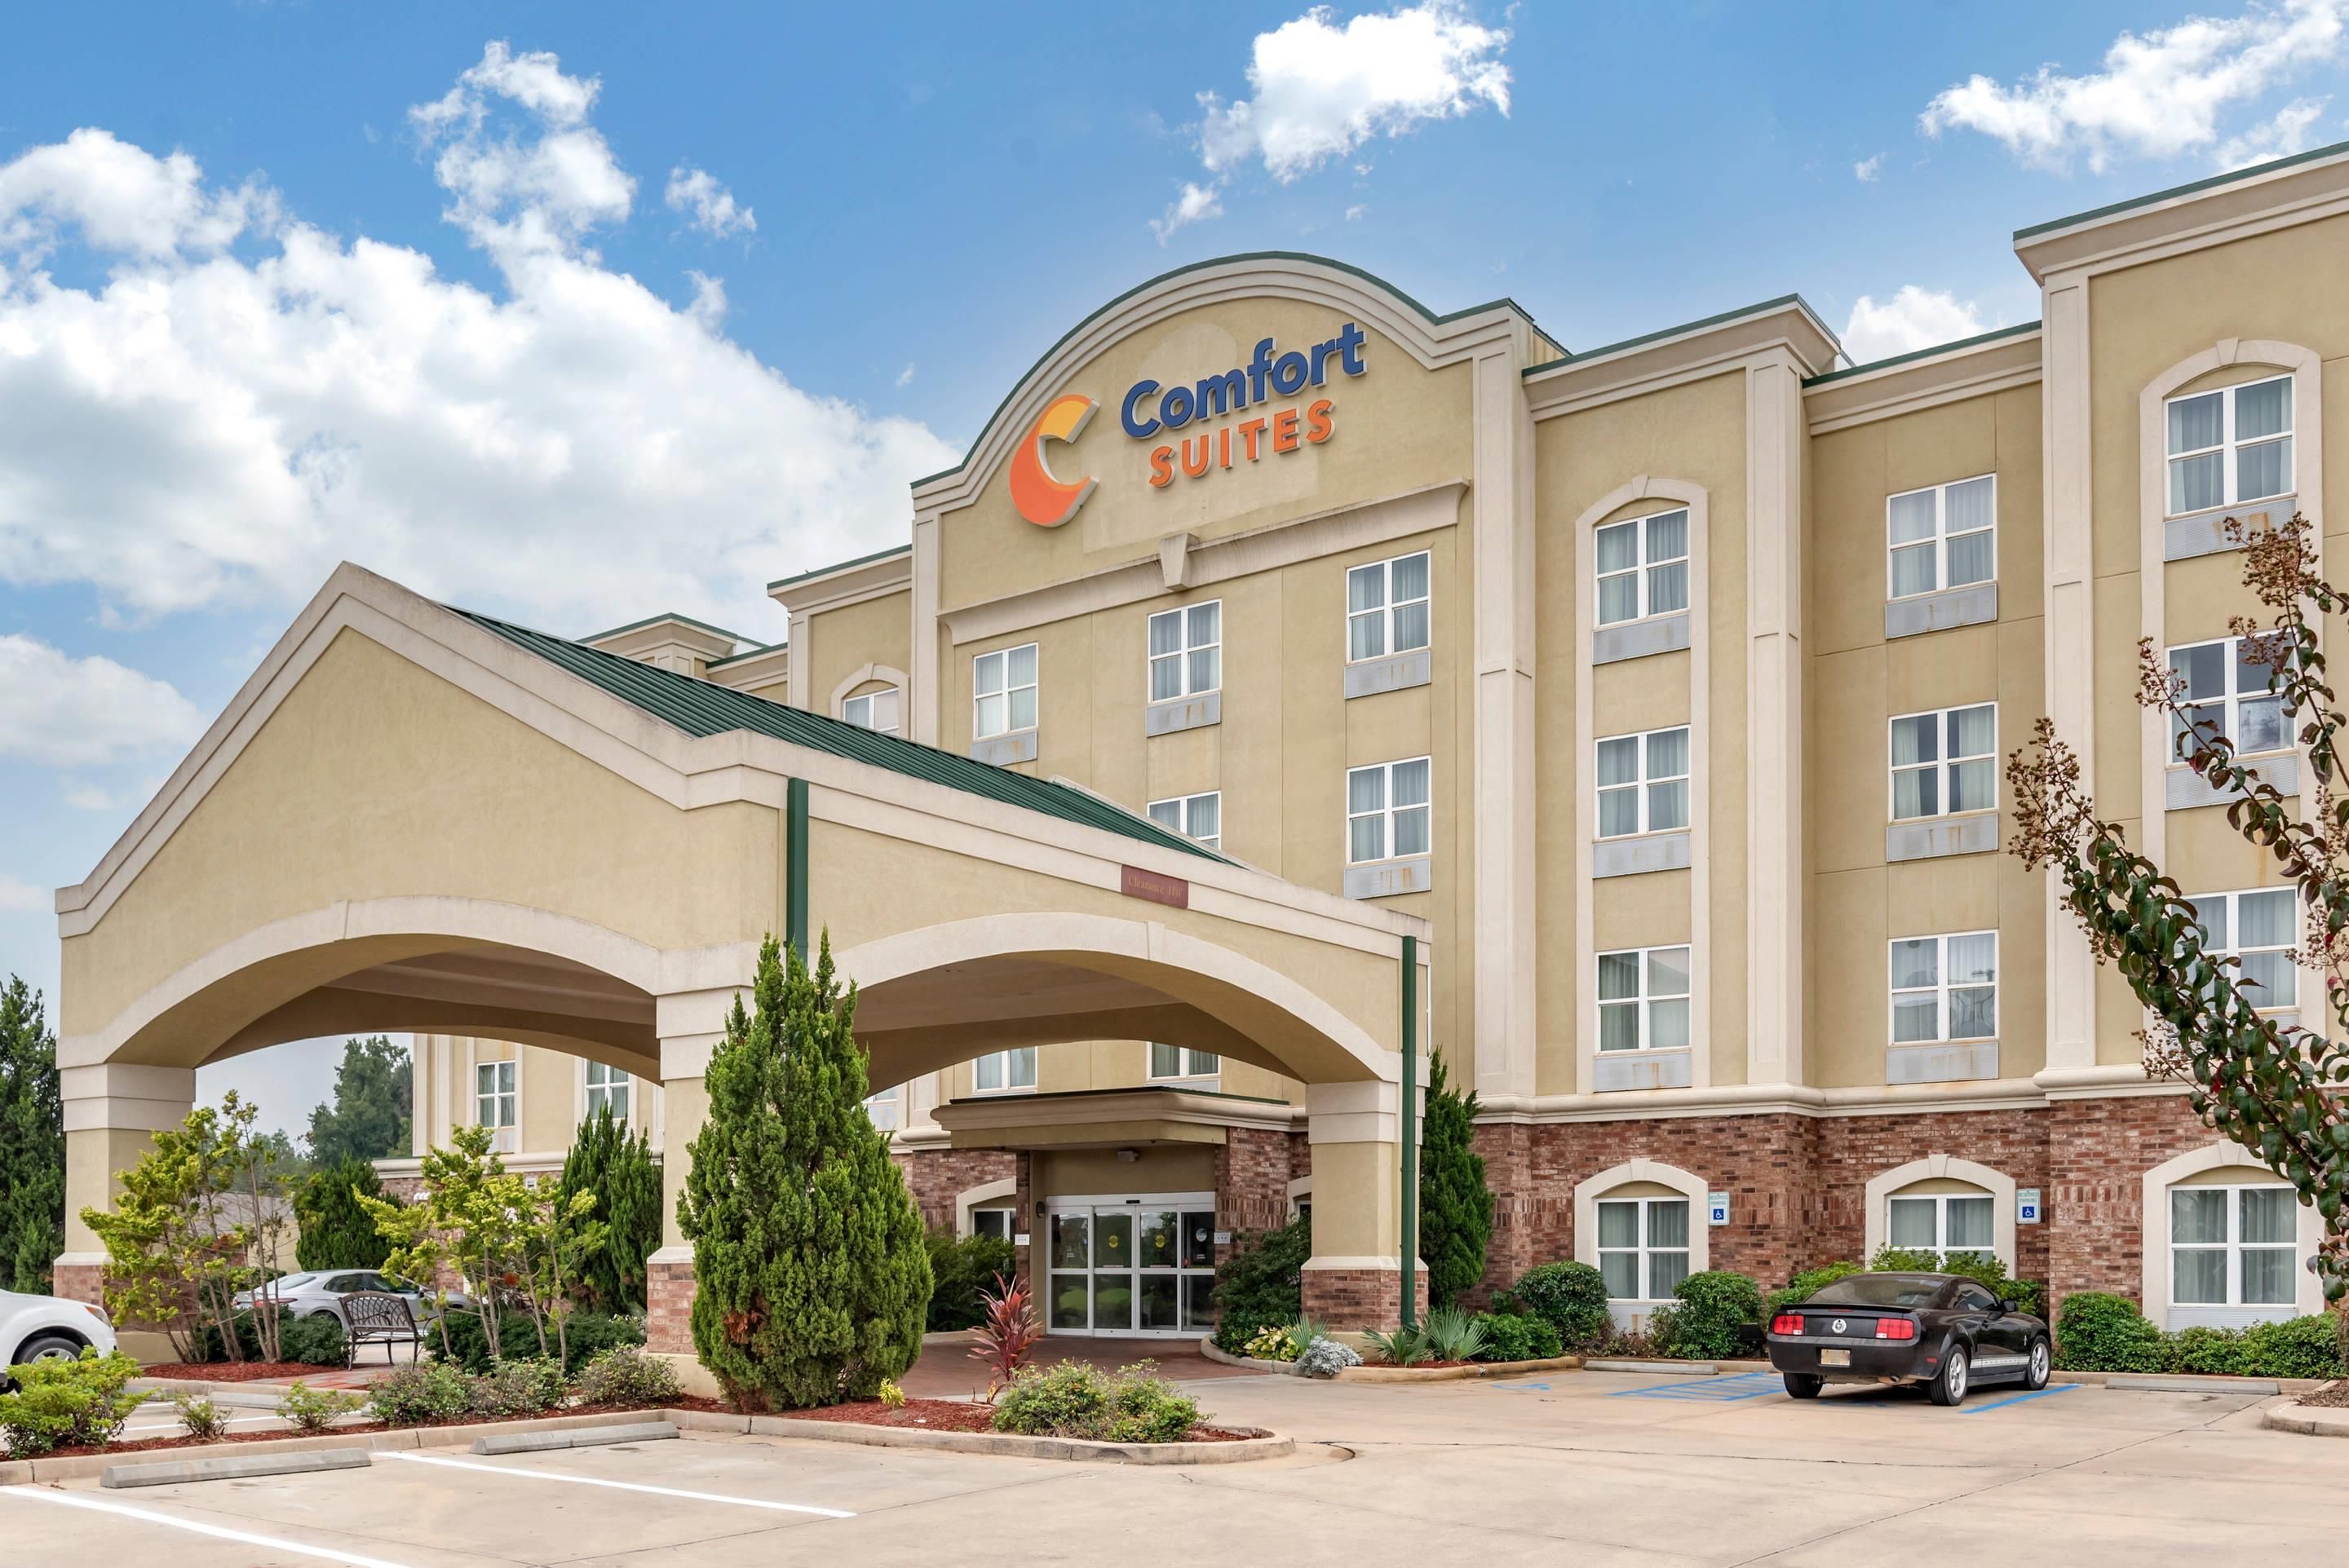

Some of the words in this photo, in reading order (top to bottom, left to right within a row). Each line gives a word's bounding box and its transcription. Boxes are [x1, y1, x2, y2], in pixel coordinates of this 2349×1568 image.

[1121, 322, 1367, 439] Comfort
[1148, 399, 1336, 488] SUITES
[1128, 874, 1166, 894] Clearance
